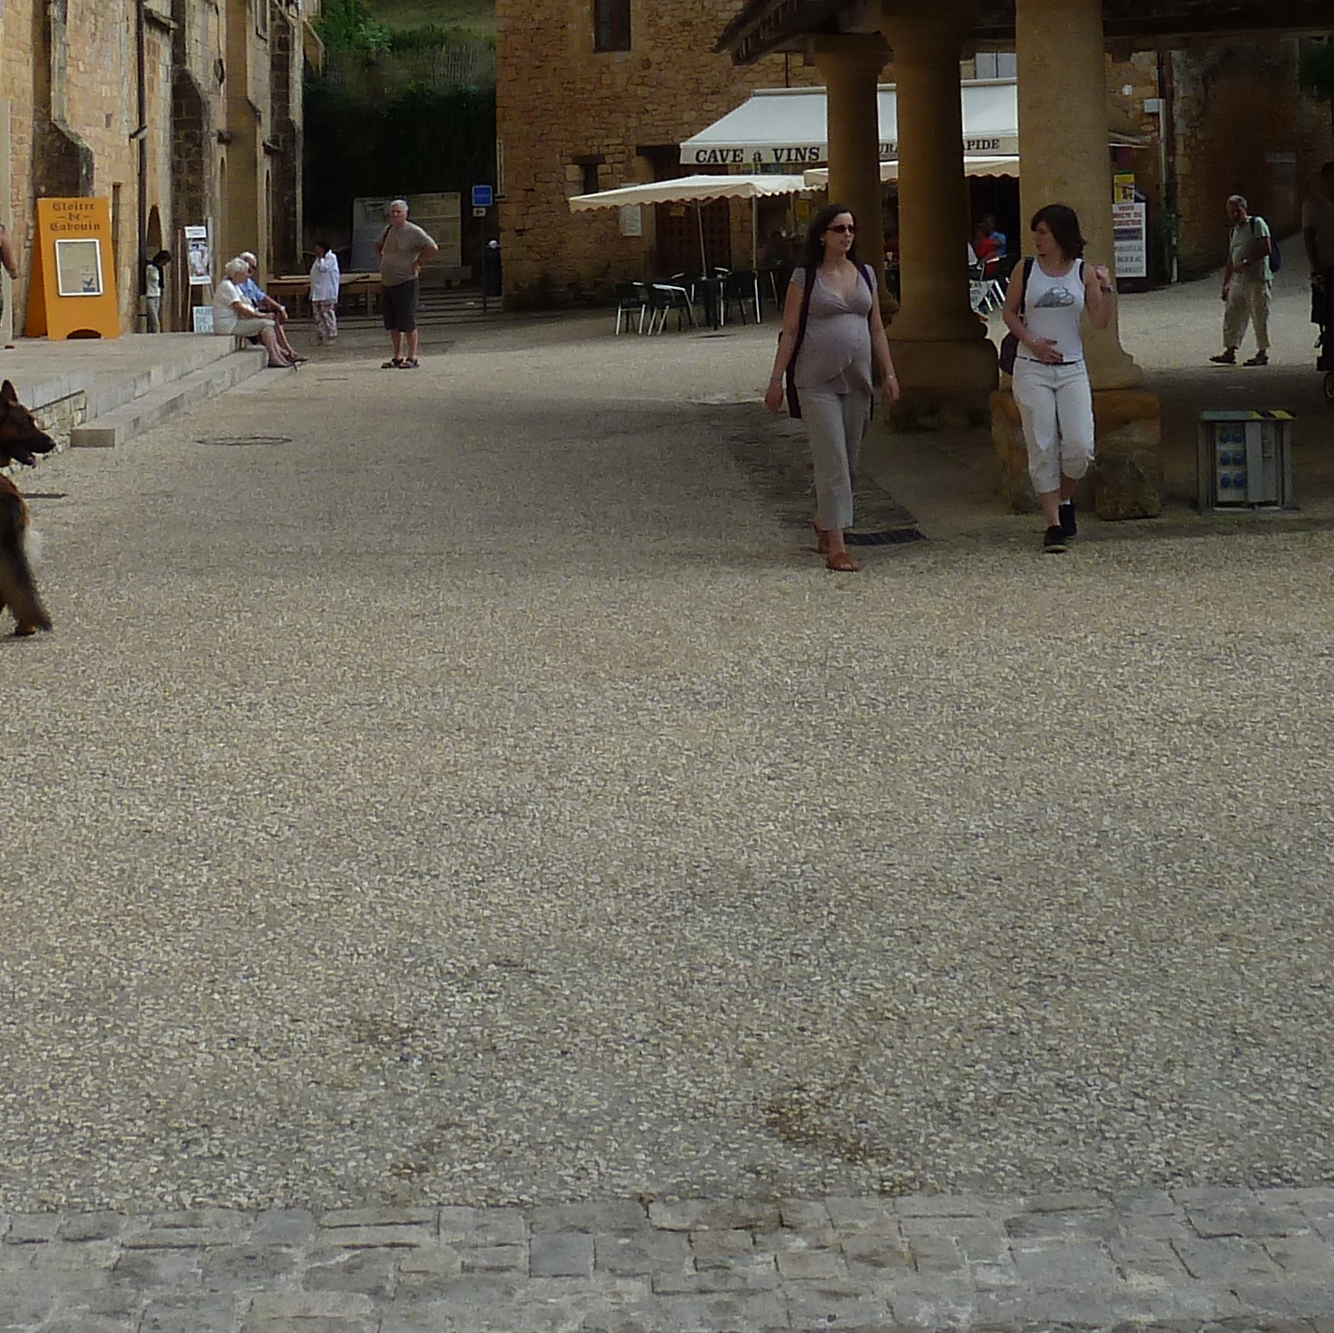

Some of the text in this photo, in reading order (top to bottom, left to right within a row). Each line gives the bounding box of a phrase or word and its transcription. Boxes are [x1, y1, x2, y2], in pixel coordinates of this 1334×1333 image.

[695, 148, 744, 164] CAVE
[771, 147, 820, 161] VINS
[50, 221, 100, 231] Cadouin
